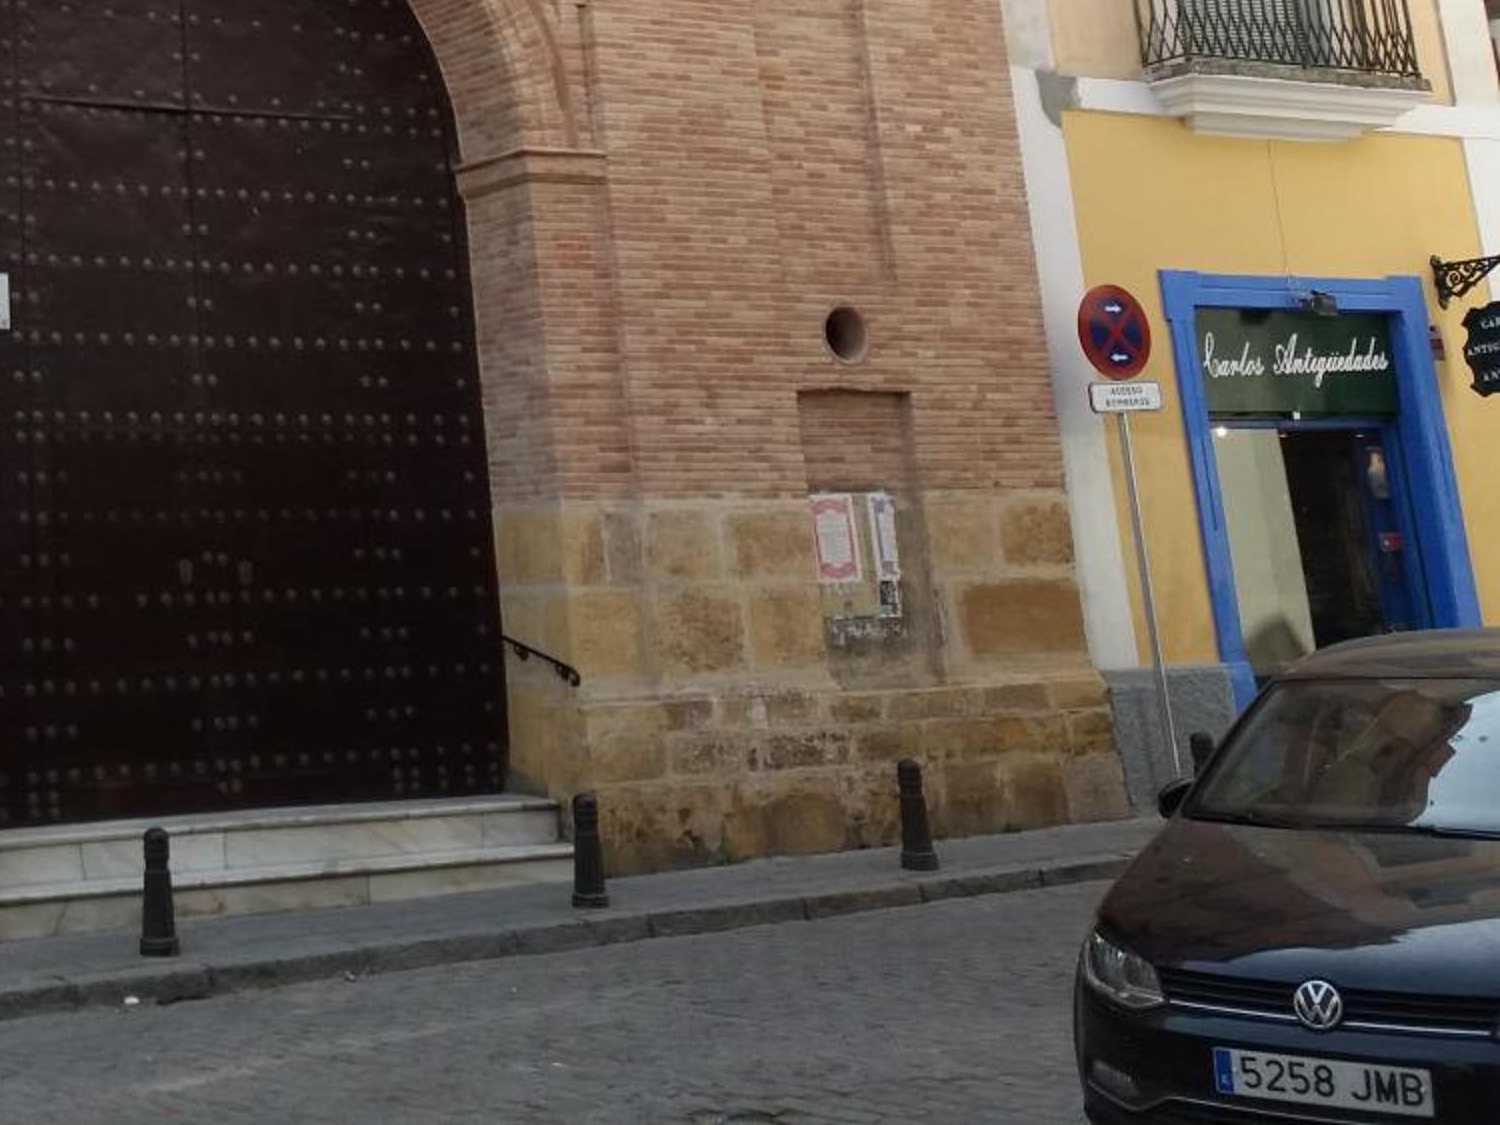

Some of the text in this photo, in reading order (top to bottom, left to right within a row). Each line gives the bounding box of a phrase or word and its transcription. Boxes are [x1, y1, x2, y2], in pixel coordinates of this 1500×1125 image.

[1204, 332, 1264, 378] Carlos
[1240, 1056, 1424, 1107] 5258 JMB
